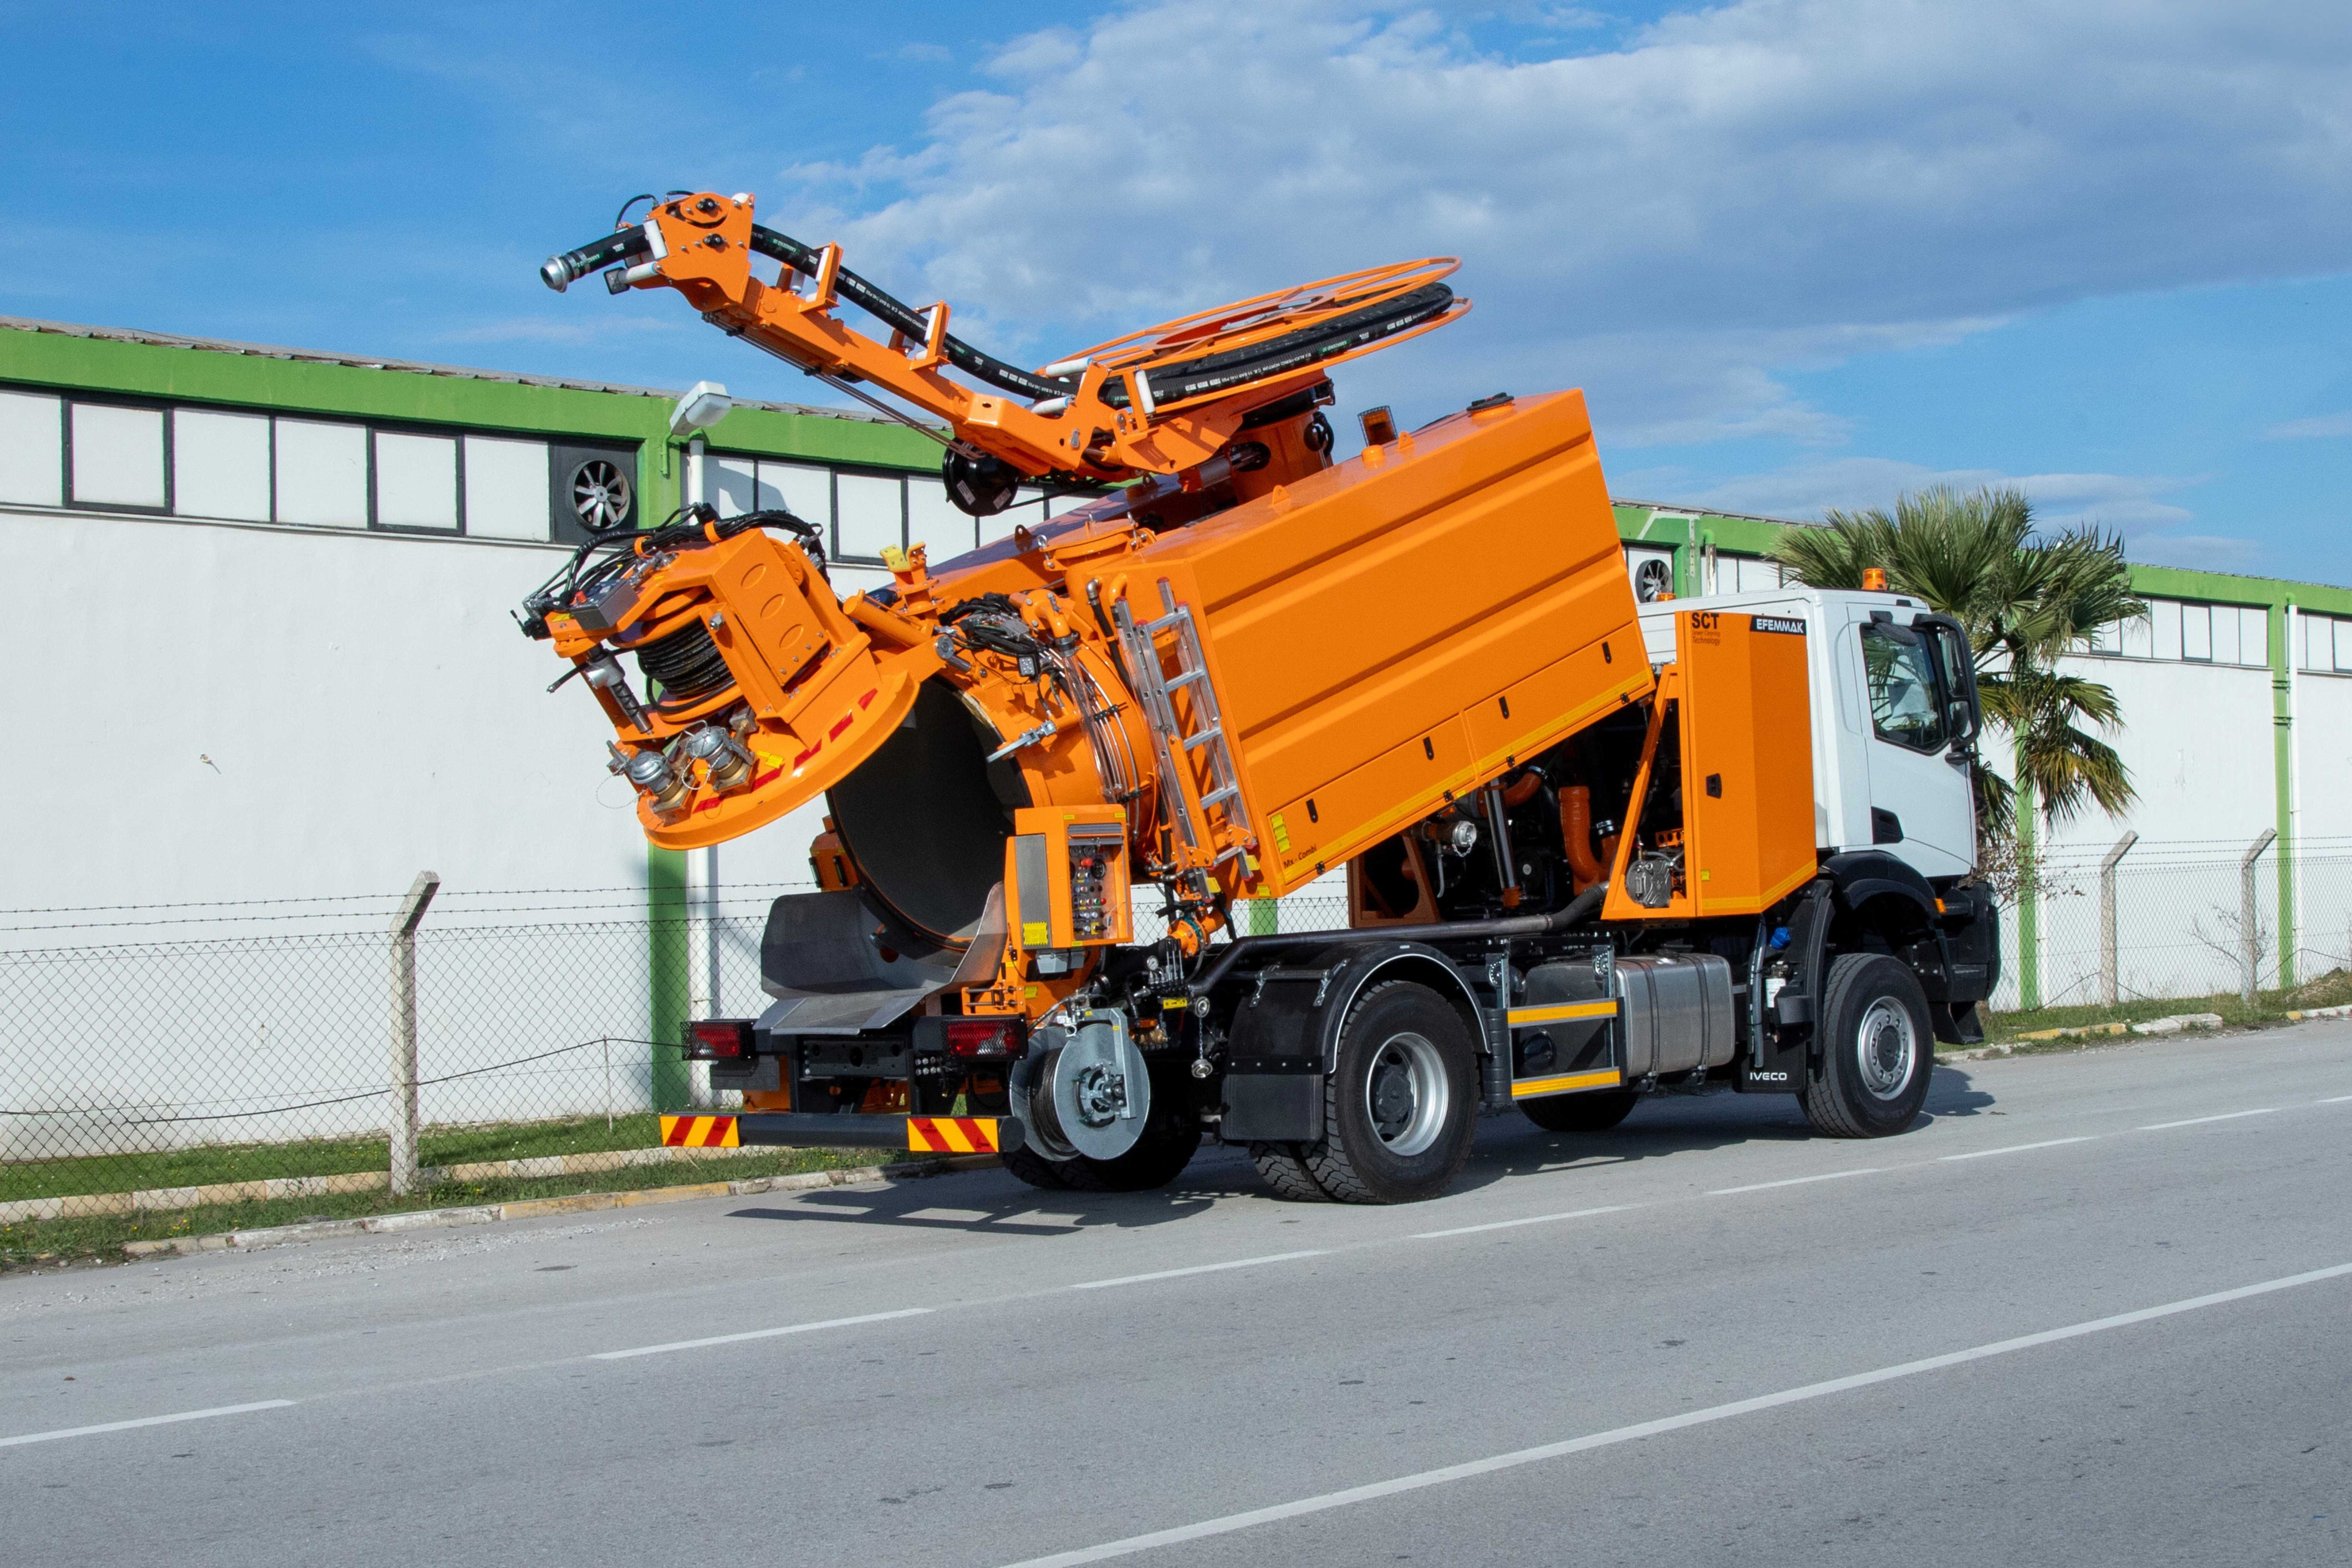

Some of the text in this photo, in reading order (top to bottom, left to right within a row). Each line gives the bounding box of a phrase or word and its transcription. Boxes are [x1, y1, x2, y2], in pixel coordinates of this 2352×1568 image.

[1692, 612, 1720, 629] SCT
[1757, 618, 1803, 633] EFEMMAK
[1692, 636, 1720, 646] Technology
[1283, 859, 1294, 869] Mx
[1298, 844, 1317, 860] Combi
